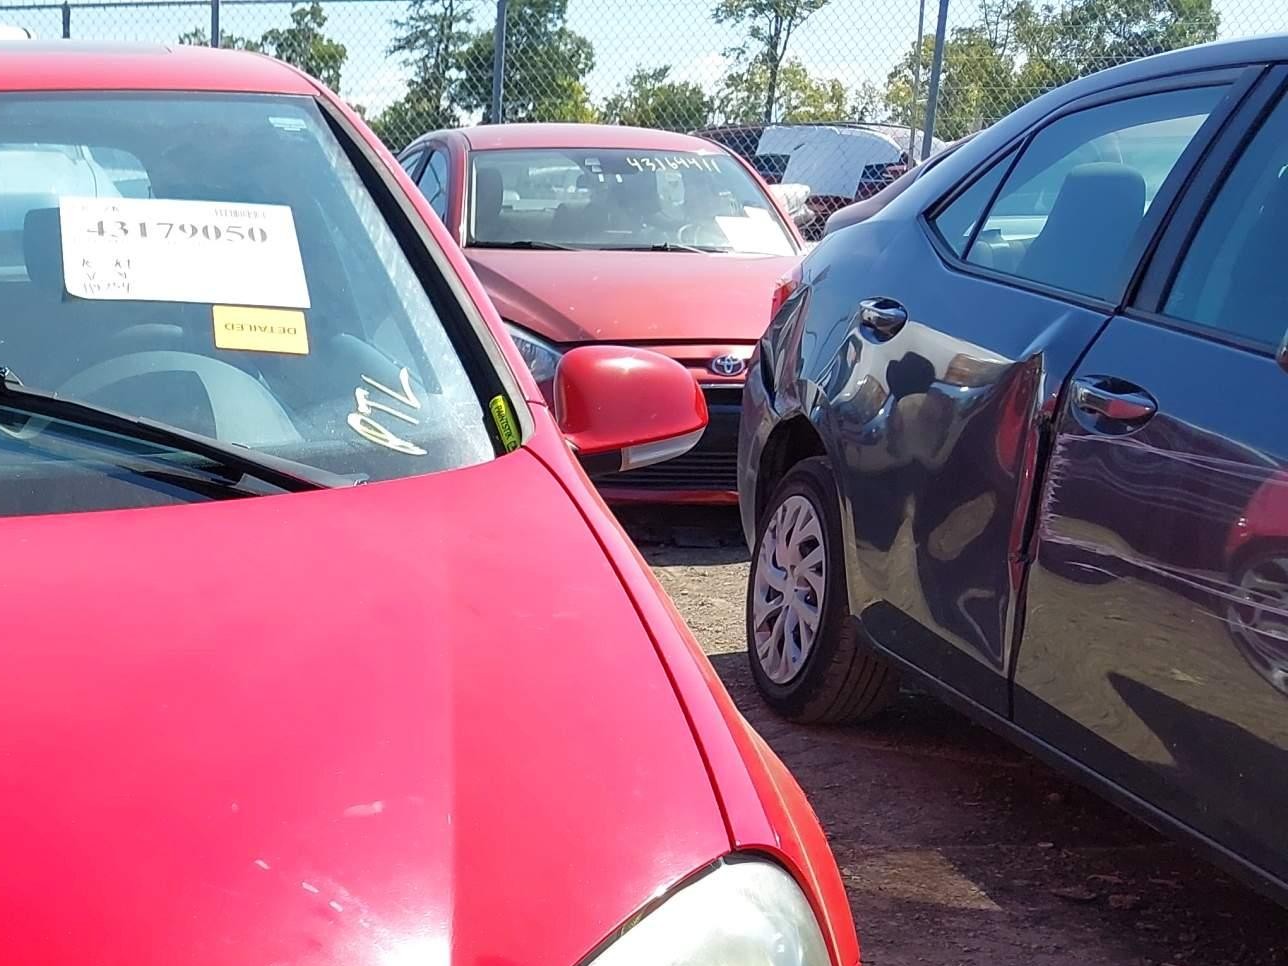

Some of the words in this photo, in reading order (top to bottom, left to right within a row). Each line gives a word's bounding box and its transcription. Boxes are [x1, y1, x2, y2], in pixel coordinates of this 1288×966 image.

[626, 156, 722, 174] 43164411
[86, 220, 268, 243] 43179050
[224, 322, 298, 336] DETAILED
